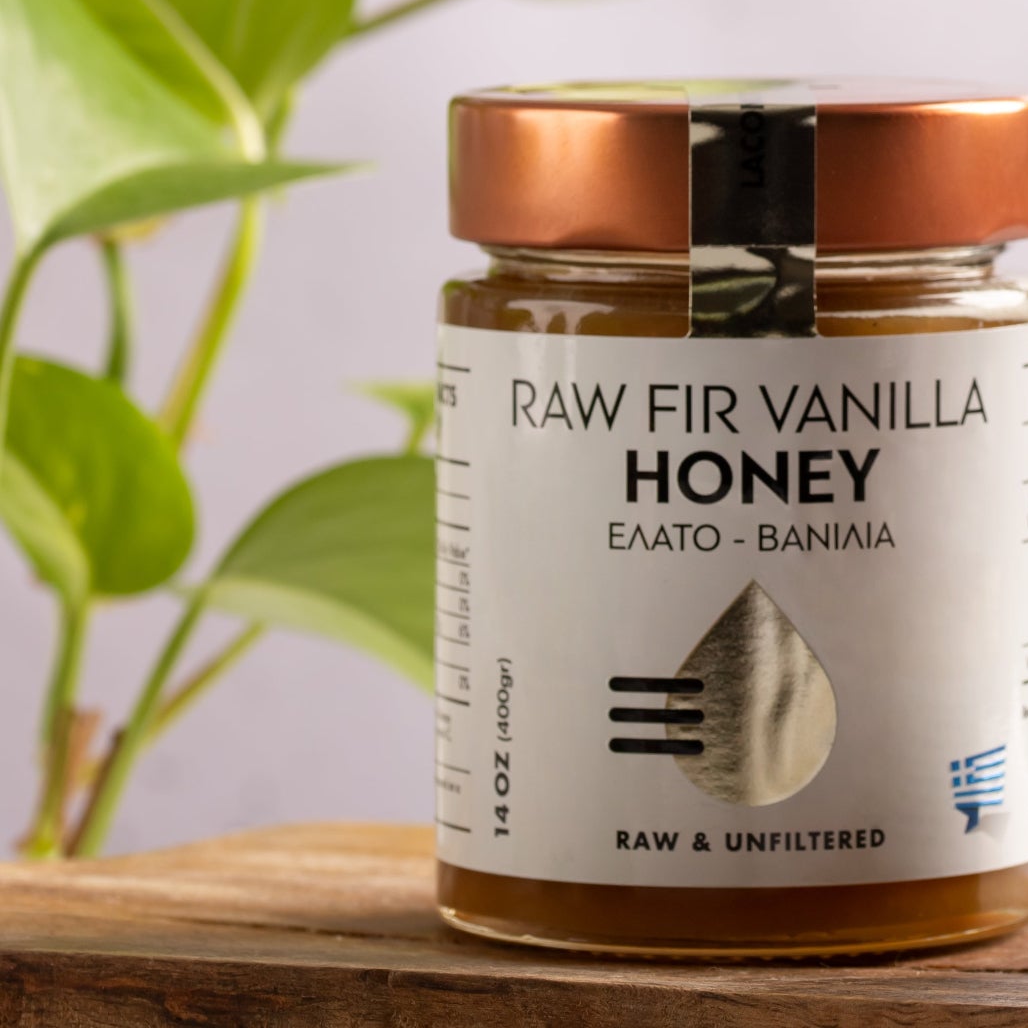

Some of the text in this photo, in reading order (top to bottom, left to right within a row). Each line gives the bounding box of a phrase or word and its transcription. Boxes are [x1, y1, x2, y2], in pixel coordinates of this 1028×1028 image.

[511, 376, 989, 434] RAW FIR VANILLA
[625, 448, 881, 505] HONEY
[608, 522, 722, 552] ΕΛΑΤΟ
[757, 521, 897, 552] ΒΑΝΙΛΙΑ
[494, 657, 514, 837] 14 OZ (400gr)
[615, 828, 886, 852] RAW & UNFILTERED
